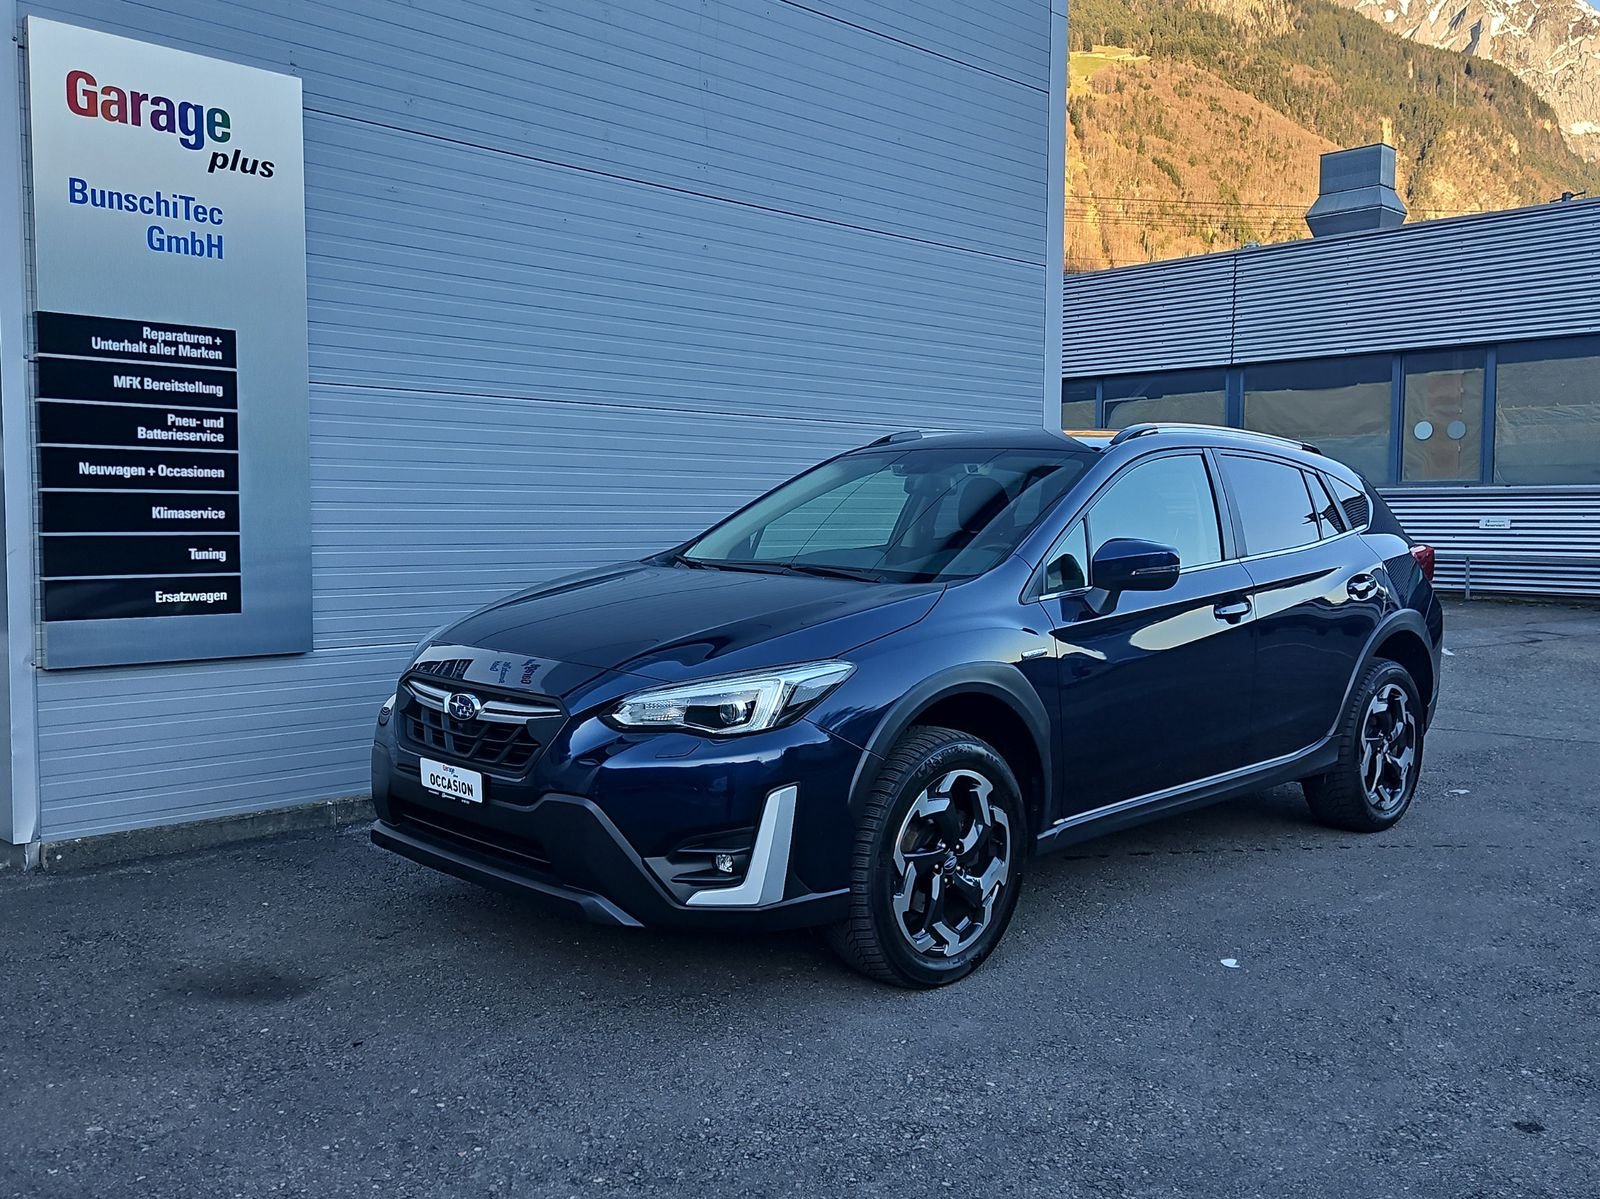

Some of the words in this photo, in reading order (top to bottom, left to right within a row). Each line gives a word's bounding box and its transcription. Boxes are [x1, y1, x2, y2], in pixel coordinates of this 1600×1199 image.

[66, 69, 231, 151] Garage
[207, 149, 275, 178] plus
[68, 177, 223, 225] BunschiTec
[147, 225, 224, 260] GmbH
[142, 327, 213, 344] Reparaturen
[214, 336, 222, 346] +
[91, 337, 148, 354] Unterhalt
[149, 341, 176, 357] aller
[178, 345, 222, 360] Marken
[113, 375, 141, 390] MFK
[144, 377, 223, 397] Bereitstellung
[167, 414, 201, 428] Pneu-
[203, 416, 224, 429] und
[137, 427, 224, 443] Batterieservice
[78, 462, 145, 478] Neuwagen
[147, 467, 156, 476] +
[158, 465, 225, 478] Occasionen
[151, 506, 226, 520] Klimaservice
[188, 548, 227, 562] Tuning
[155, 591, 228, 604] Ersatzwagen
[430, 773, 474, 797] OCCASION
